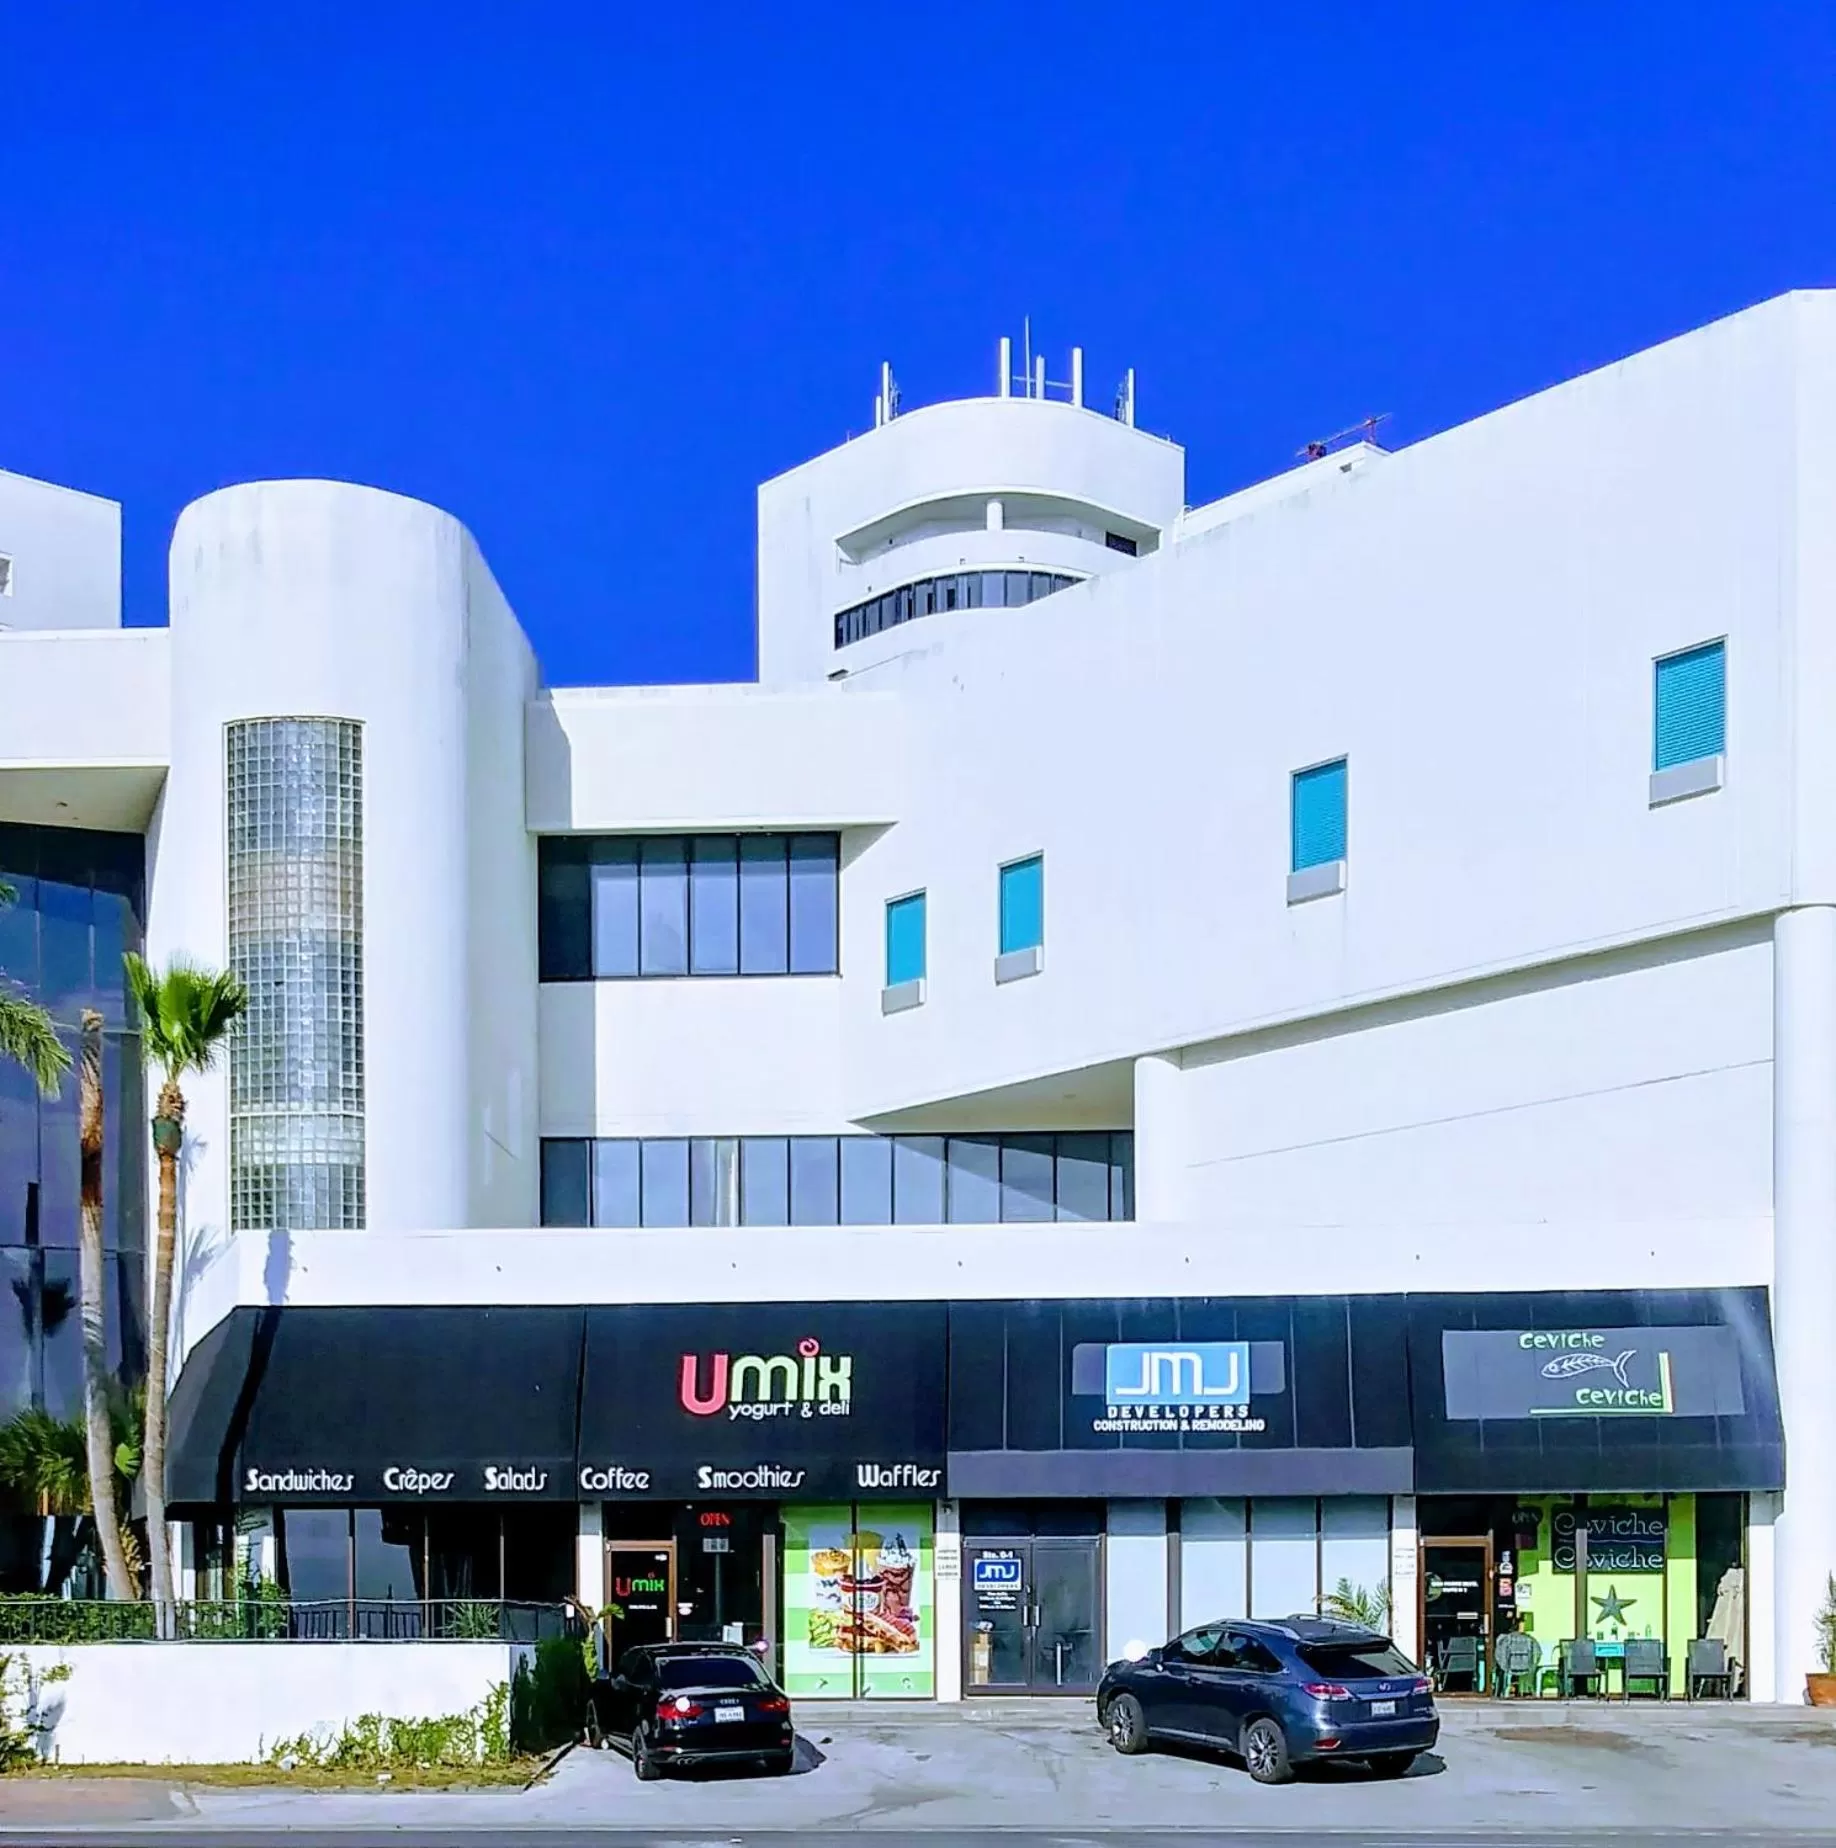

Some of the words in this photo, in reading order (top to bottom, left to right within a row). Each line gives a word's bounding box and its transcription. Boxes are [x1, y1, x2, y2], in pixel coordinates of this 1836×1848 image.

[729, 1402, 794, 1420] yogurt
[800, 1402, 813, 1418] &
[819, 1401, 850, 1416] deli
[1107, 1405, 1250, 1418] DEVELOPERS
[1093, 1419, 1178, 1432] CONSTRUCTION
[1180, 1420, 1190, 1431] &
[1192, 1419, 1265, 1431] REMODELING
[245, 1468, 355, 1491] Sandwiches
[383, 1467, 455, 1494] Crêpes
[485, 1466, 547, 1491] Salads
[580, 1466, 650, 1490] Coffee
[698, 1465, 805, 1489] Smoothies
[857, 1464, 942, 1488] Waffles
